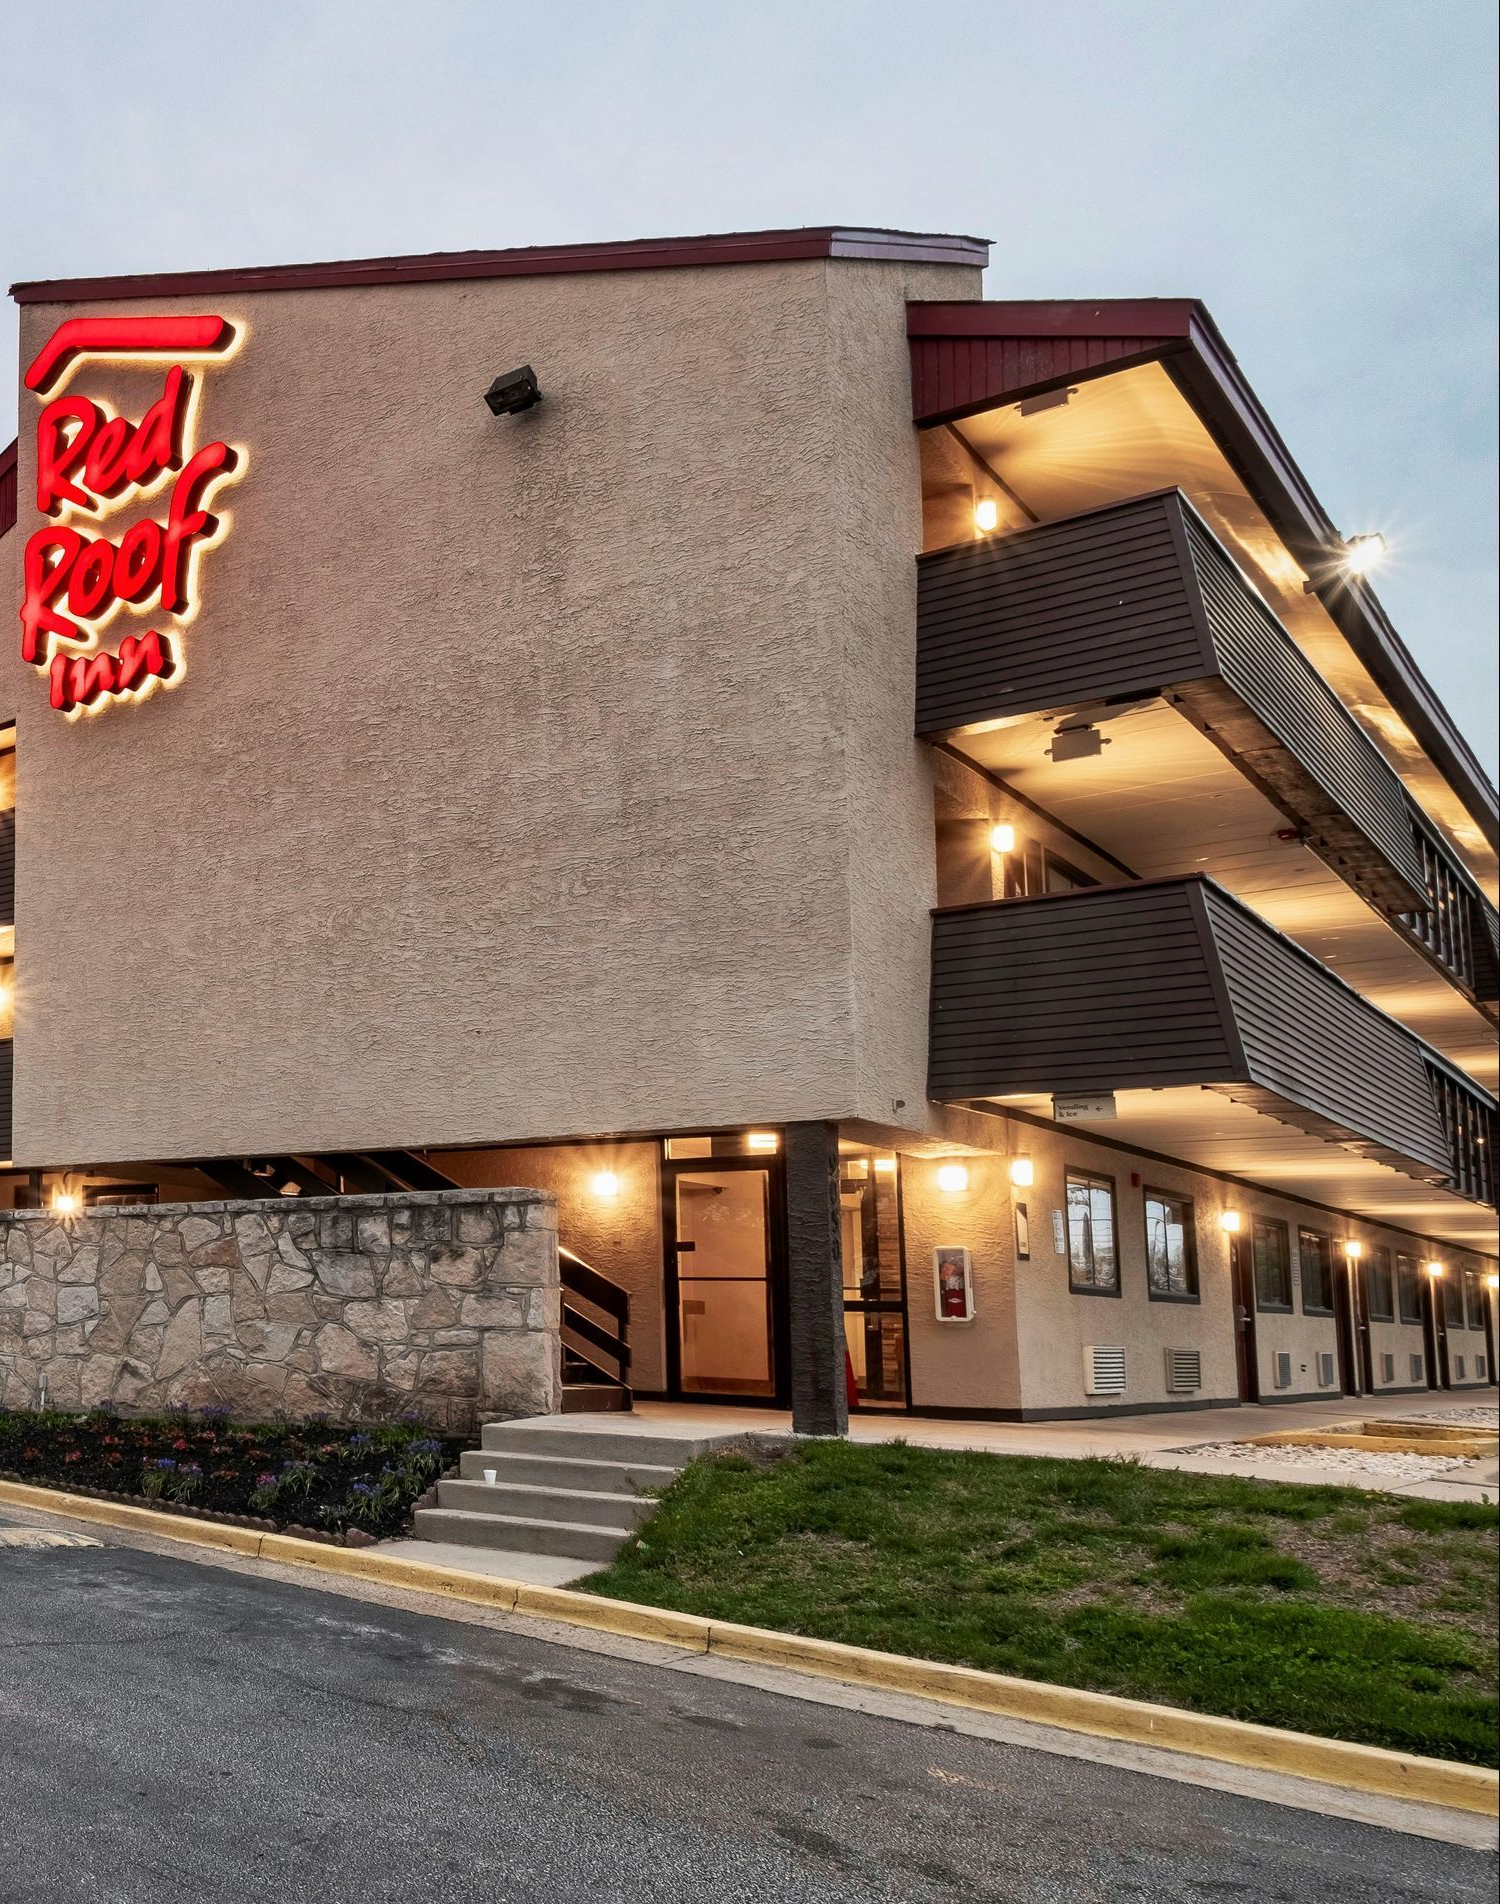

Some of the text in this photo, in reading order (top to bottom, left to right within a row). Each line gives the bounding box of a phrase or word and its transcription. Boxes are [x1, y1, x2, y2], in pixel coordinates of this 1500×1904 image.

[37, 364, 189, 515] Red
[20, 441, 233, 664] Roof
[1057, 1103, 1089, 1111] Vending
